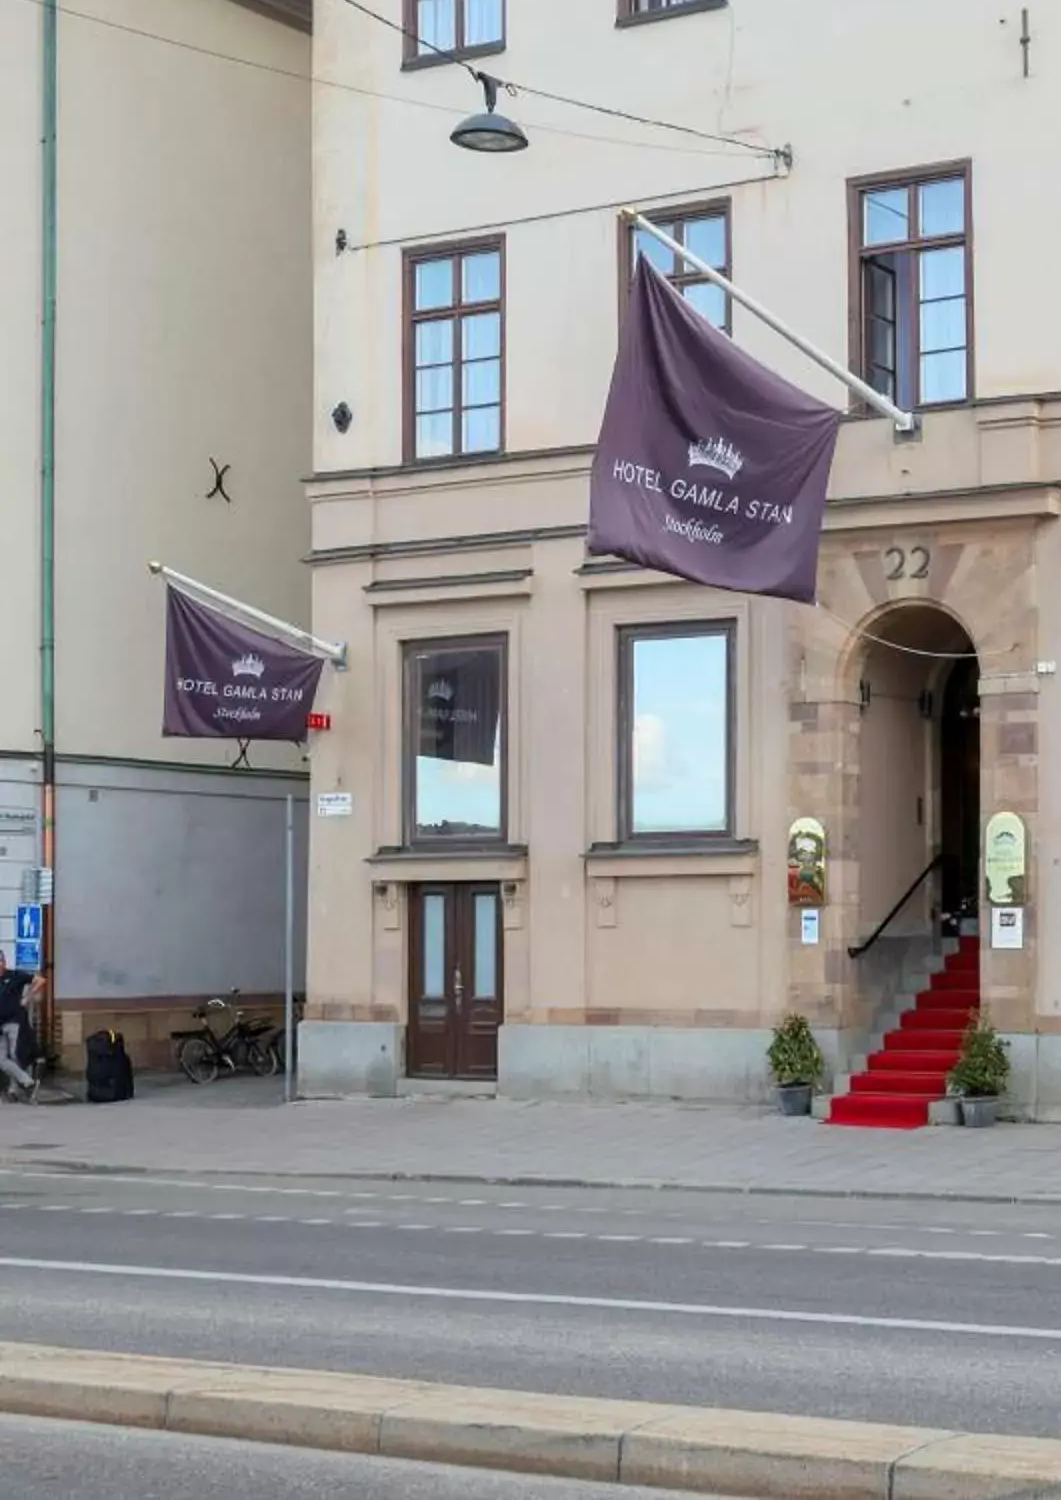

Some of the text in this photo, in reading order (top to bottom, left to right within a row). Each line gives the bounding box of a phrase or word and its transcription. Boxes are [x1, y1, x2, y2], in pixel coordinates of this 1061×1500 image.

[613, 459, 794, 524] HOTEL GAMLA STAN
[662, 514, 724, 543] Stockholm
[885, 546, 930, 580] 22
[223, 684, 268, 700] GAMLA
[271, 687, 304, 701] STAN
